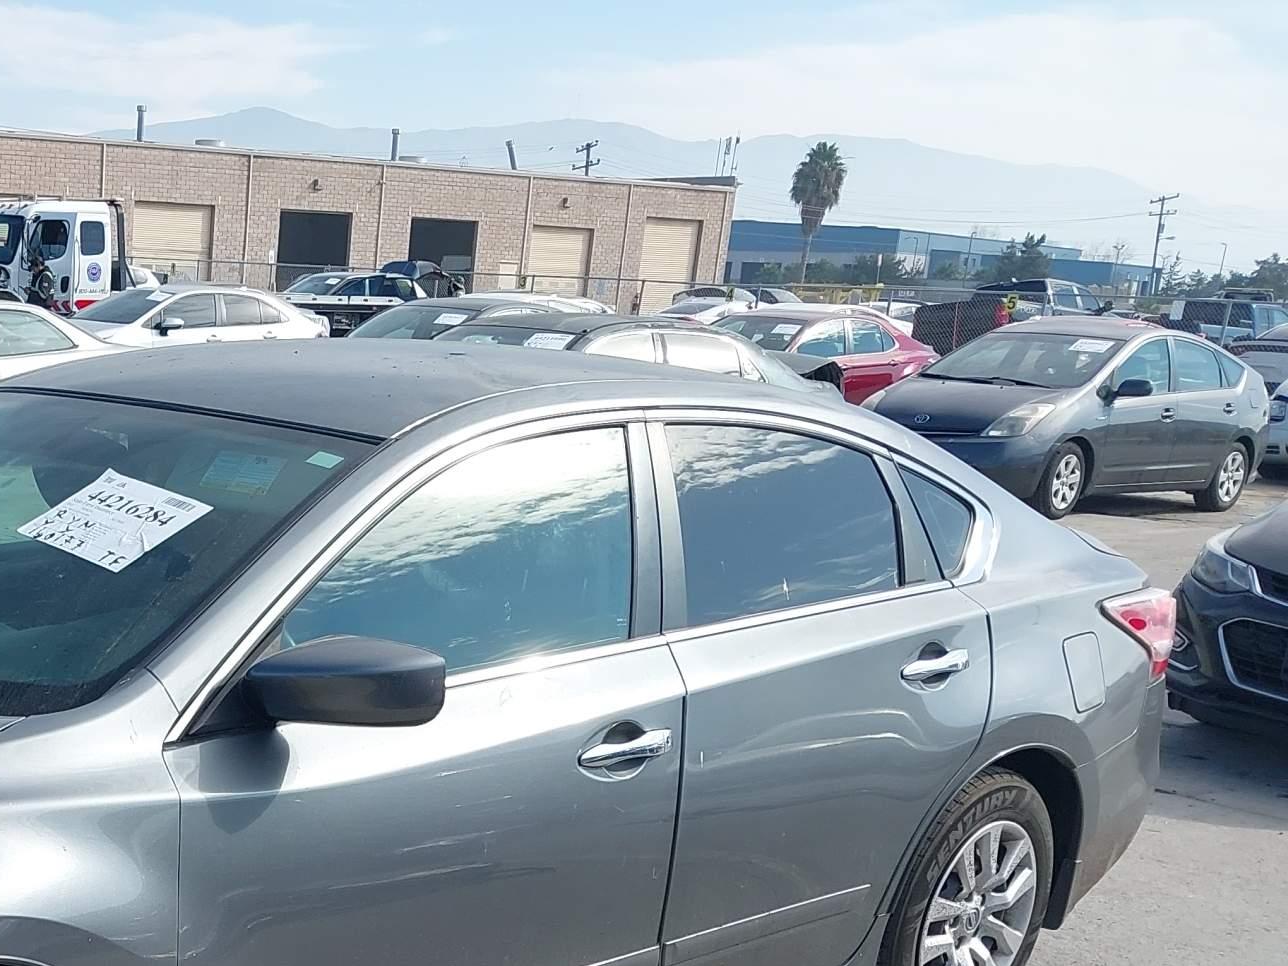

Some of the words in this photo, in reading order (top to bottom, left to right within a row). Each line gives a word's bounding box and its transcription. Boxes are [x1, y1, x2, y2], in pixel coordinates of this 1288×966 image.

[1007, 296, 1017, 310] 5
[88, 490, 177, 527] 44216284
[926, 790, 1018, 883] SENTURY
